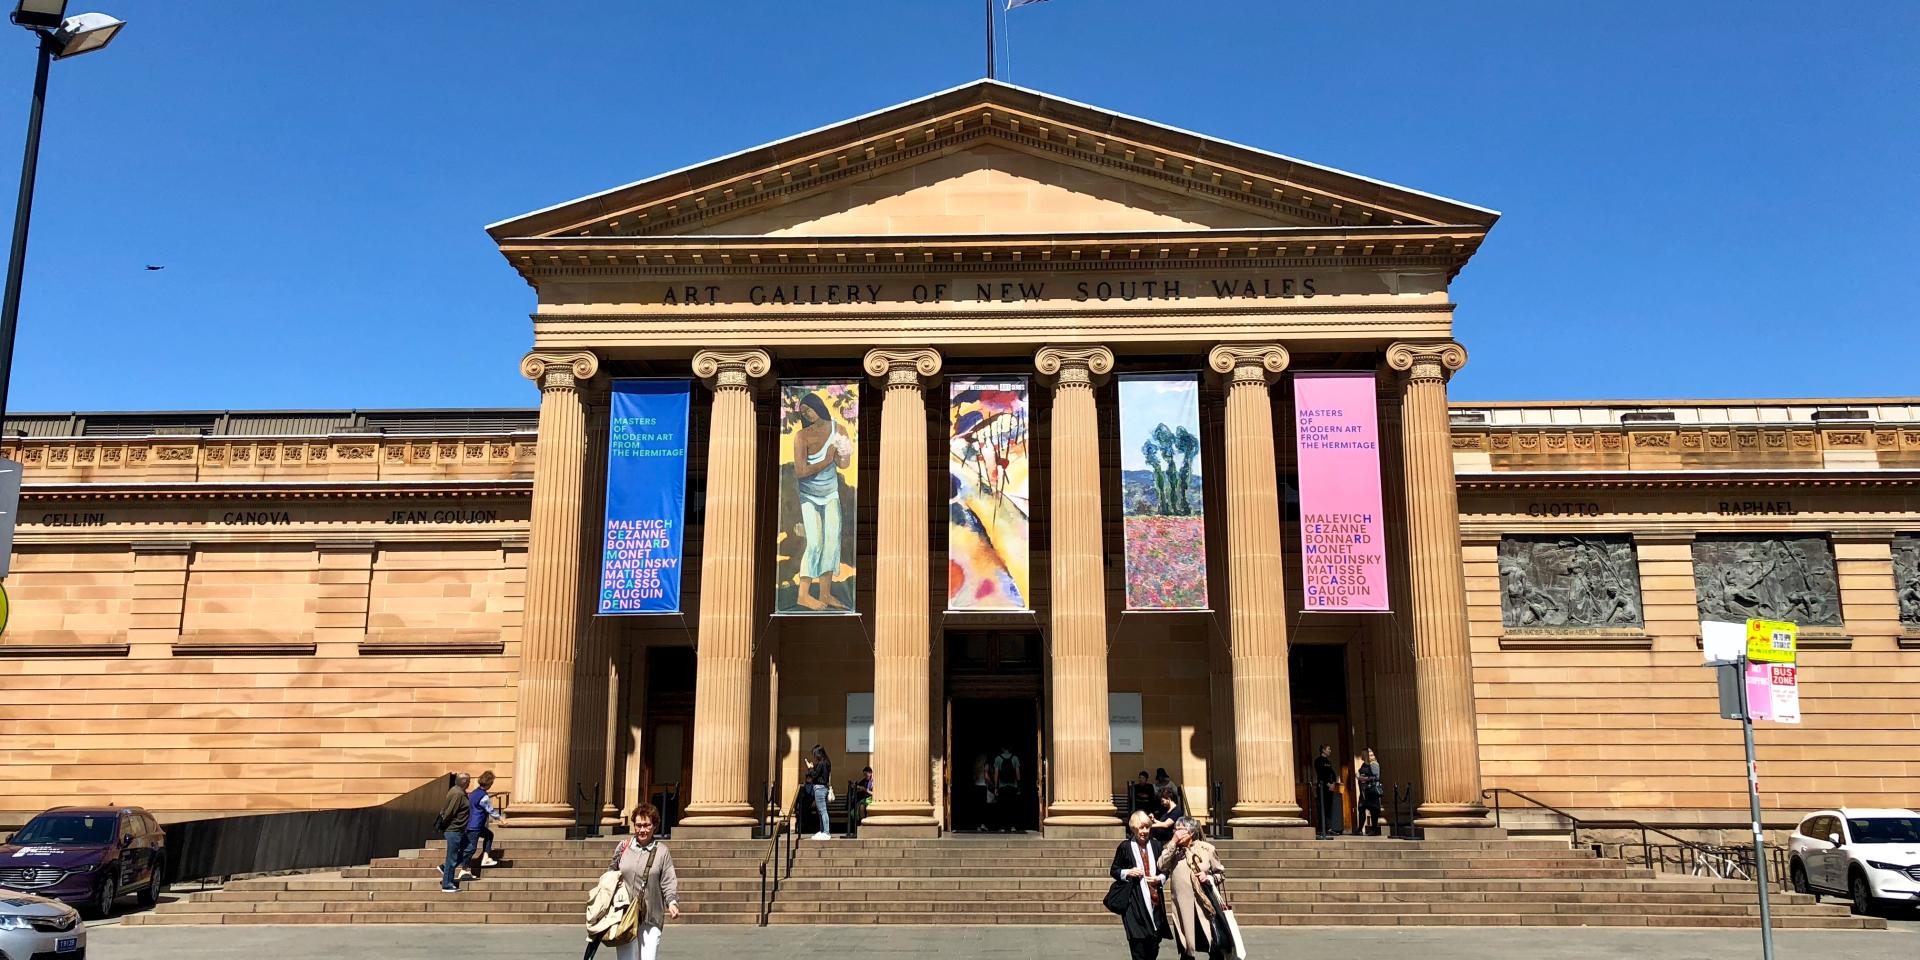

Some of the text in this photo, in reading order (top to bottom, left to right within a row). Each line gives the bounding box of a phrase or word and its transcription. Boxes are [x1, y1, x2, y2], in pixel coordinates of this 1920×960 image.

[662, 278, 1316, 306] ART GALLERY OF NEW SOUTH WALES
[1321, 442, 1376, 450] HERMITAGE
[632, 449, 684, 457] HERMITAGE
[1528, 503, 1600, 517] GIOTTO
[1718, 501, 1798, 516] RAPHAEL
[42, 513, 105, 527] CELLINI
[223, 511, 291, 526] CANOVA
[385, 510, 497, 525] JEAN GOUJON
[1304, 514, 1372, 524] MALEVICH
[608, 519, 673, 530] MALEVICH
[1305, 524, 1367, 534] CEZANNE
[608, 529, 667, 540] CEZANNE
[1305, 534, 1371, 544] BONNARD
[607, 539, 670, 550] BONNARD
[1306, 544, 1353, 554] MONET
[606, 549, 652, 560] MONET
[1306, 554, 1381, 565] KANDINSKY
[606, 558, 678, 570] KANDINSKY
[605, 568, 659, 580] MATISSE
[1307, 565, 1363, 575] MATISSE
[604, 578, 661, 590] PICASSO
[1307, 575, 1366, 585] PICASSO
[603, 588, 663, 599] GAUGUIN
[1308, 585, 1371, 596] GAUGUIN
[602, 599, 641, 610] DENIS
[1308, 596, 1349, 606] DENIS
[1773, 667, 1792, 677] BUS
[1773, 675, 1795, 685] ZONE
